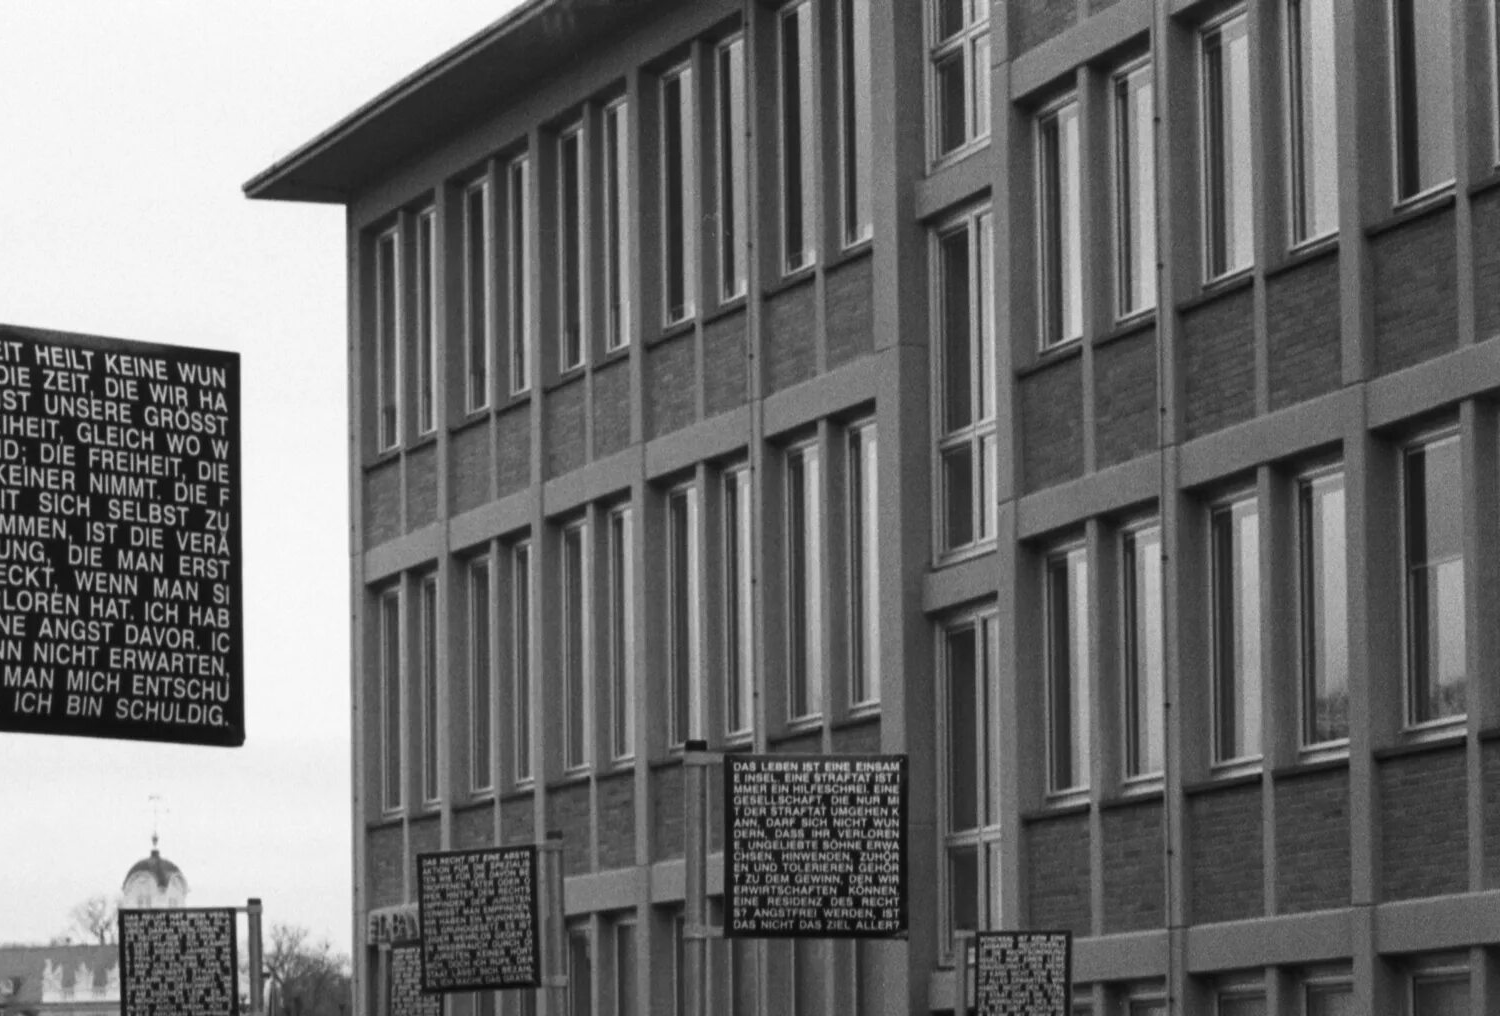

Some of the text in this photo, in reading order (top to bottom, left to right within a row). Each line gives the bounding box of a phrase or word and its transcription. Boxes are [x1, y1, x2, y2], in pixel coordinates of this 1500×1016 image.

[34, 345, 94, 370] HEILT
[104, 354, 166, 379] KEINE
[176, 363, 225, 387] WUN
[42, 369, 95, 398] ZEIT,
[104, 377, 137, 399] DIE
[148, 382, 188, 405] WIR
[199, 389, 225, 411] HA
[44, 395, 131, 422] UNSERE
[143, 402, 228, 434] GRÖSST
[76, 423, 154, 449] GLEICH
[165, 433, 200, 455] WO
[210, 439, 229, 459] W
[40, 443, 75, 465] DIE
[88, 449, 187, 481] FREIHEIT,
[198, 461, 228, 483] DIE
[89, 473, 161, 498] NIMMT.
[174, 482, 206, 504] DIE
[219, 487, 229, 507] F
[38, 492, 90, 516] SICH
[108, 500, 189, 526] SELBST
[205, 510, 229, 531] ZU
[86, 521, 118, 543] IST
[130, 526, 162, 548] DIE
[176, 527, 229, 554] VERÄ
[68, 545, 102, 567] DIE
[117, 550, 163, 572] MAN
[179, 556, 230, 579] ERST
[74, 571, 137, 595] WENN
[153, 578, 198, 600] MAN
[212, 584, 229, 604] SI
[90, 596, 133, 619] HAT.
[144, 601, 178, 623] ICH
[188, 606, 229, 628] HAB
[38, 617, 113, 642] ANGST
[124, 624, 200, 649] DAVOR.
[211, 632, 229, 652] IC
[33, 642, 99, 666] NICHT
[109, 648, 230, 679] ERWARTEN,
[3, 665, 54, 688] MAN
[66, 670, 120, 692] MICH
[131, 675, 229, 701] ENTSCHU
[14, 692, 52, 713] ICH
[66, 695, 102, 716] BIN
[115, 699, 228, 725] SCHULDIG.
[733, 761, 900, 772] DAS LEBEN IST EINE EINSAM
[784, 773, 872, 783] EINE STRAFTAT
[733, 784, 767, 794] MMER
[873, 784, 899, 794] EINE
[766, 818, 867, 828] DARF SICH NICHT
[770, 806, 889, 816] STRAFTAT UMGEHEN
[774, 829, 805, 839] DASS
[837, 829, 900, 839] VERLOREN
[866, 841, 900, 850] ERWA
[733, 897, 900, 907] EINE RESIDENZ RECHT
[753, 908, 817, 918] ANGSTFREI
[761, 920, 795, 930] NICHT
[826, 920, 850, 930] ZIEL
